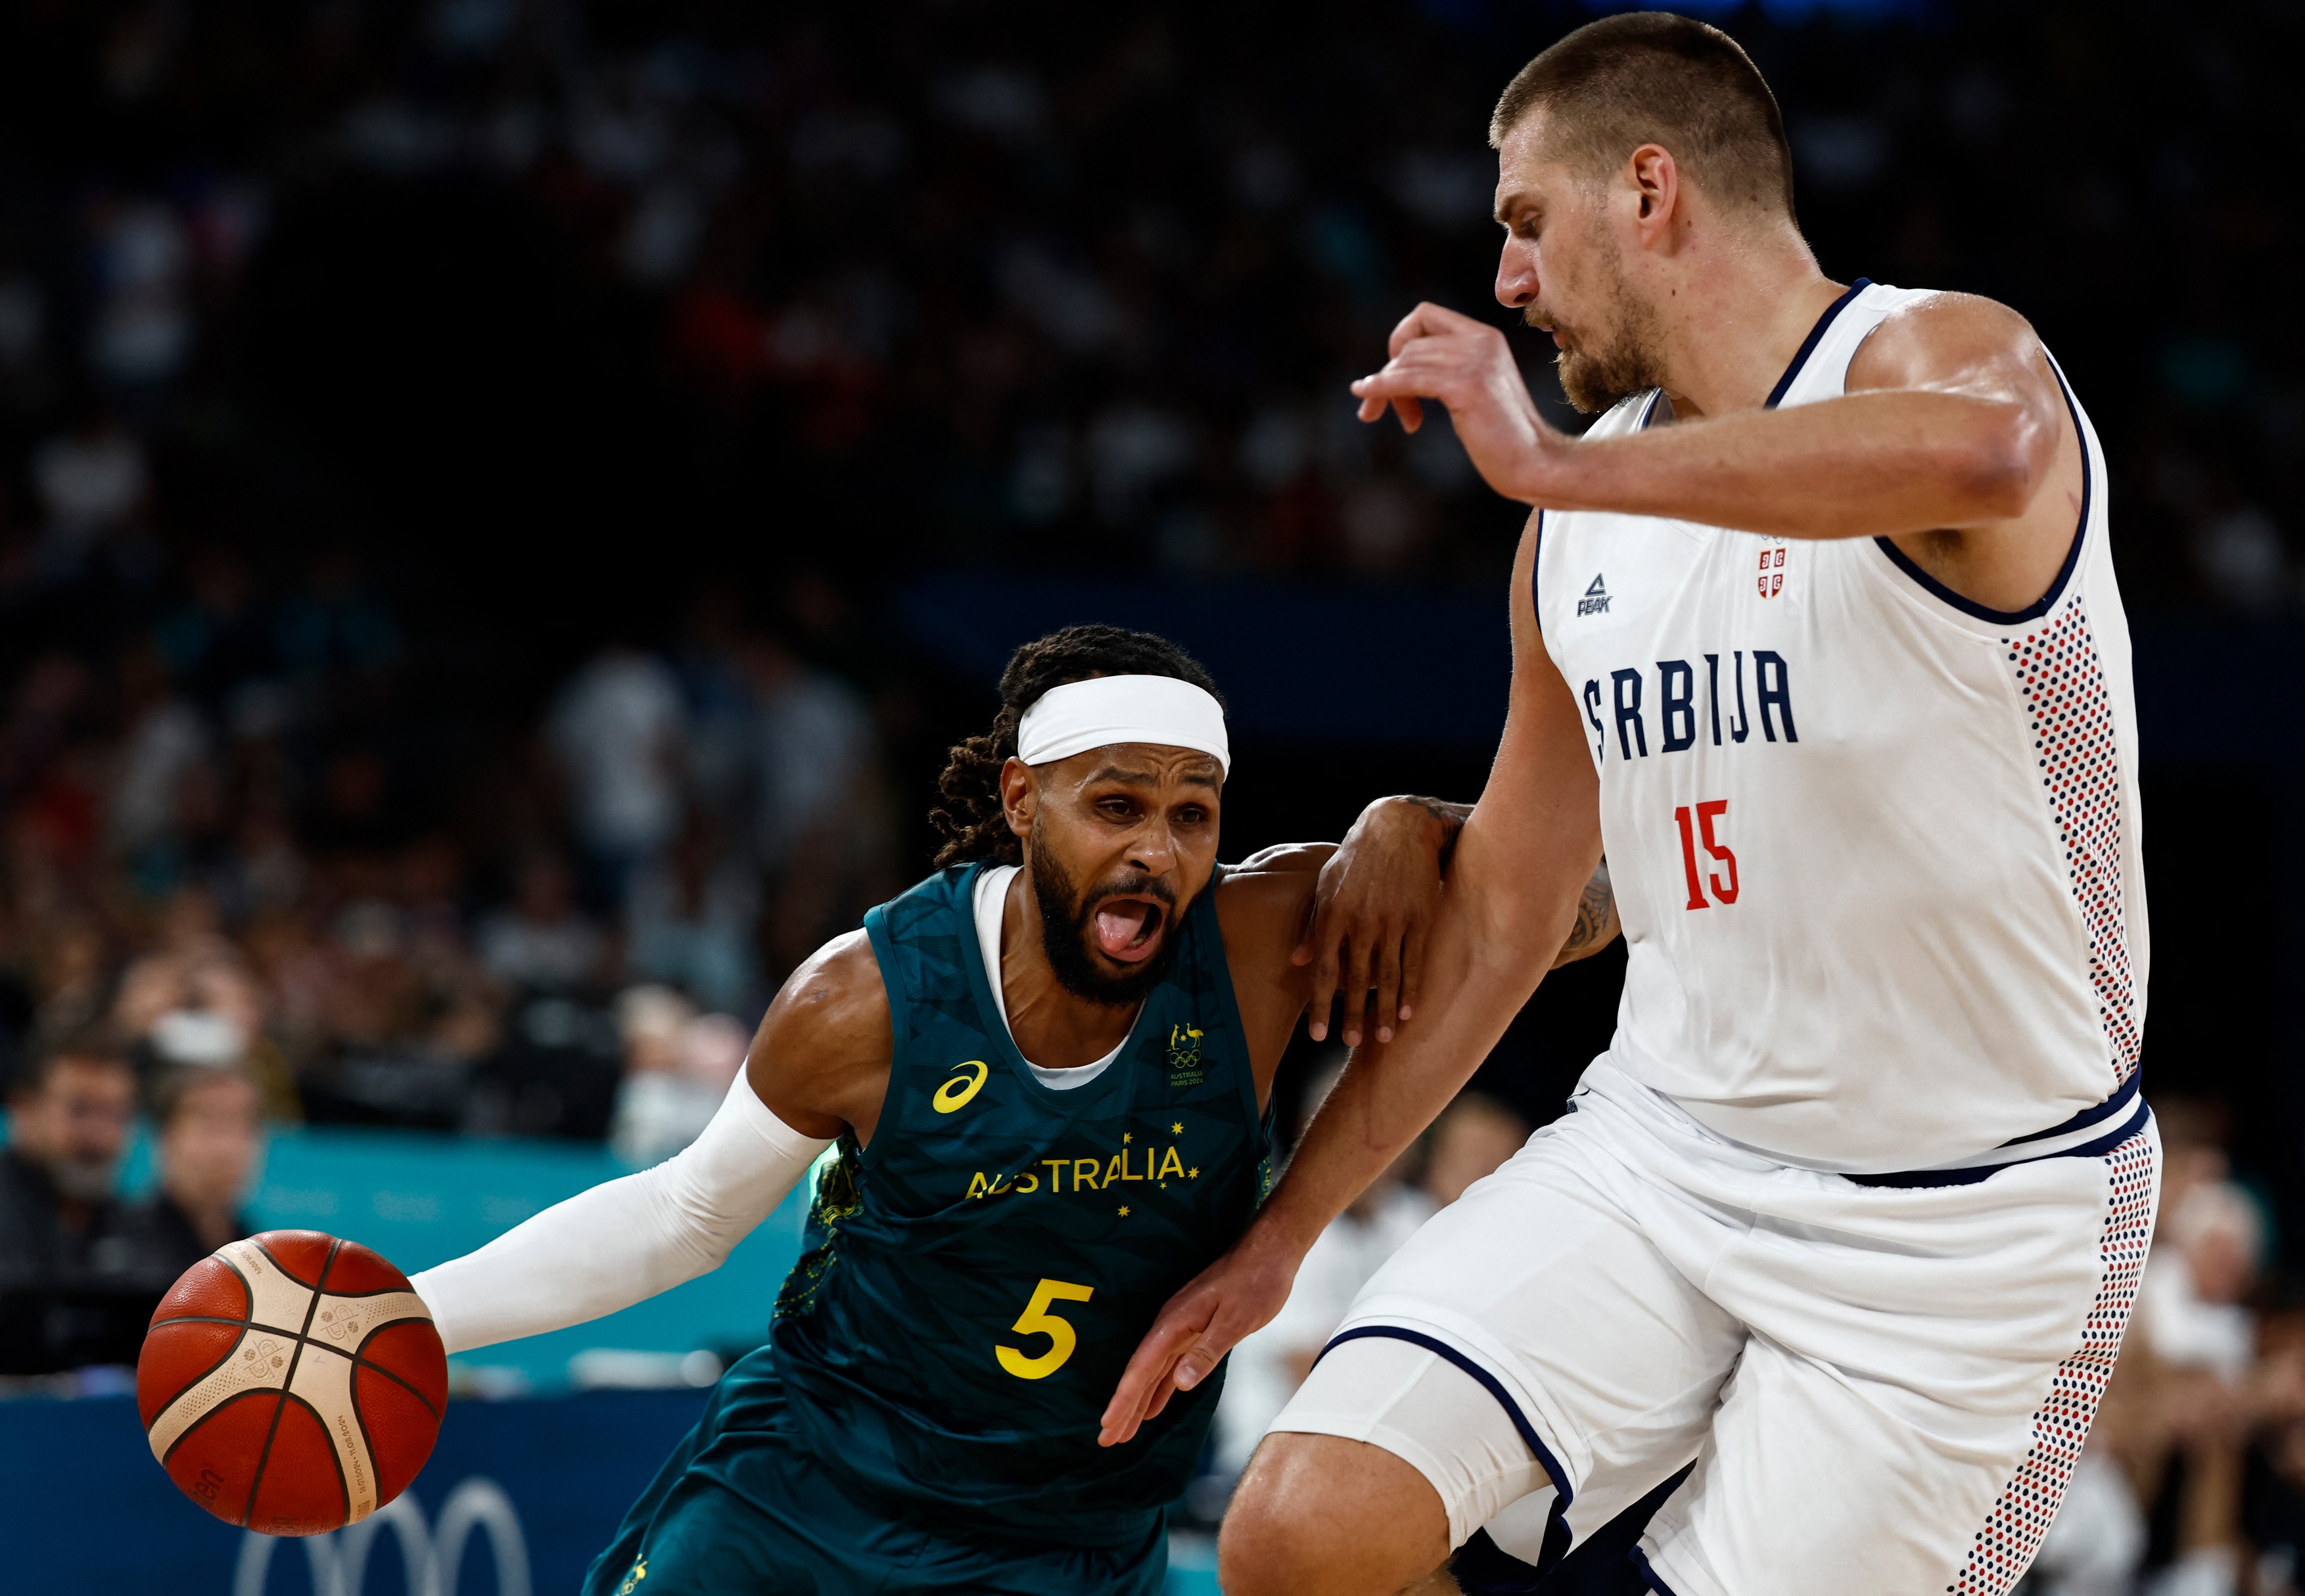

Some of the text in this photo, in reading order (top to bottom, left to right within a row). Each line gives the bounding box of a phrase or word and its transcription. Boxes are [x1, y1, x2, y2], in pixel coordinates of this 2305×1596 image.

[1577, 596, 1613, 617] PEAK
[1583, 650, 1798, 766] SRBIJA
[1675, 800, 1739, 911] 15
[1171, 1070, 1203, 1080] AUSTRALIA
[995, 1278, 1094, 1379] 5
[337, 1415, 356, 1456] 11.08.2024
